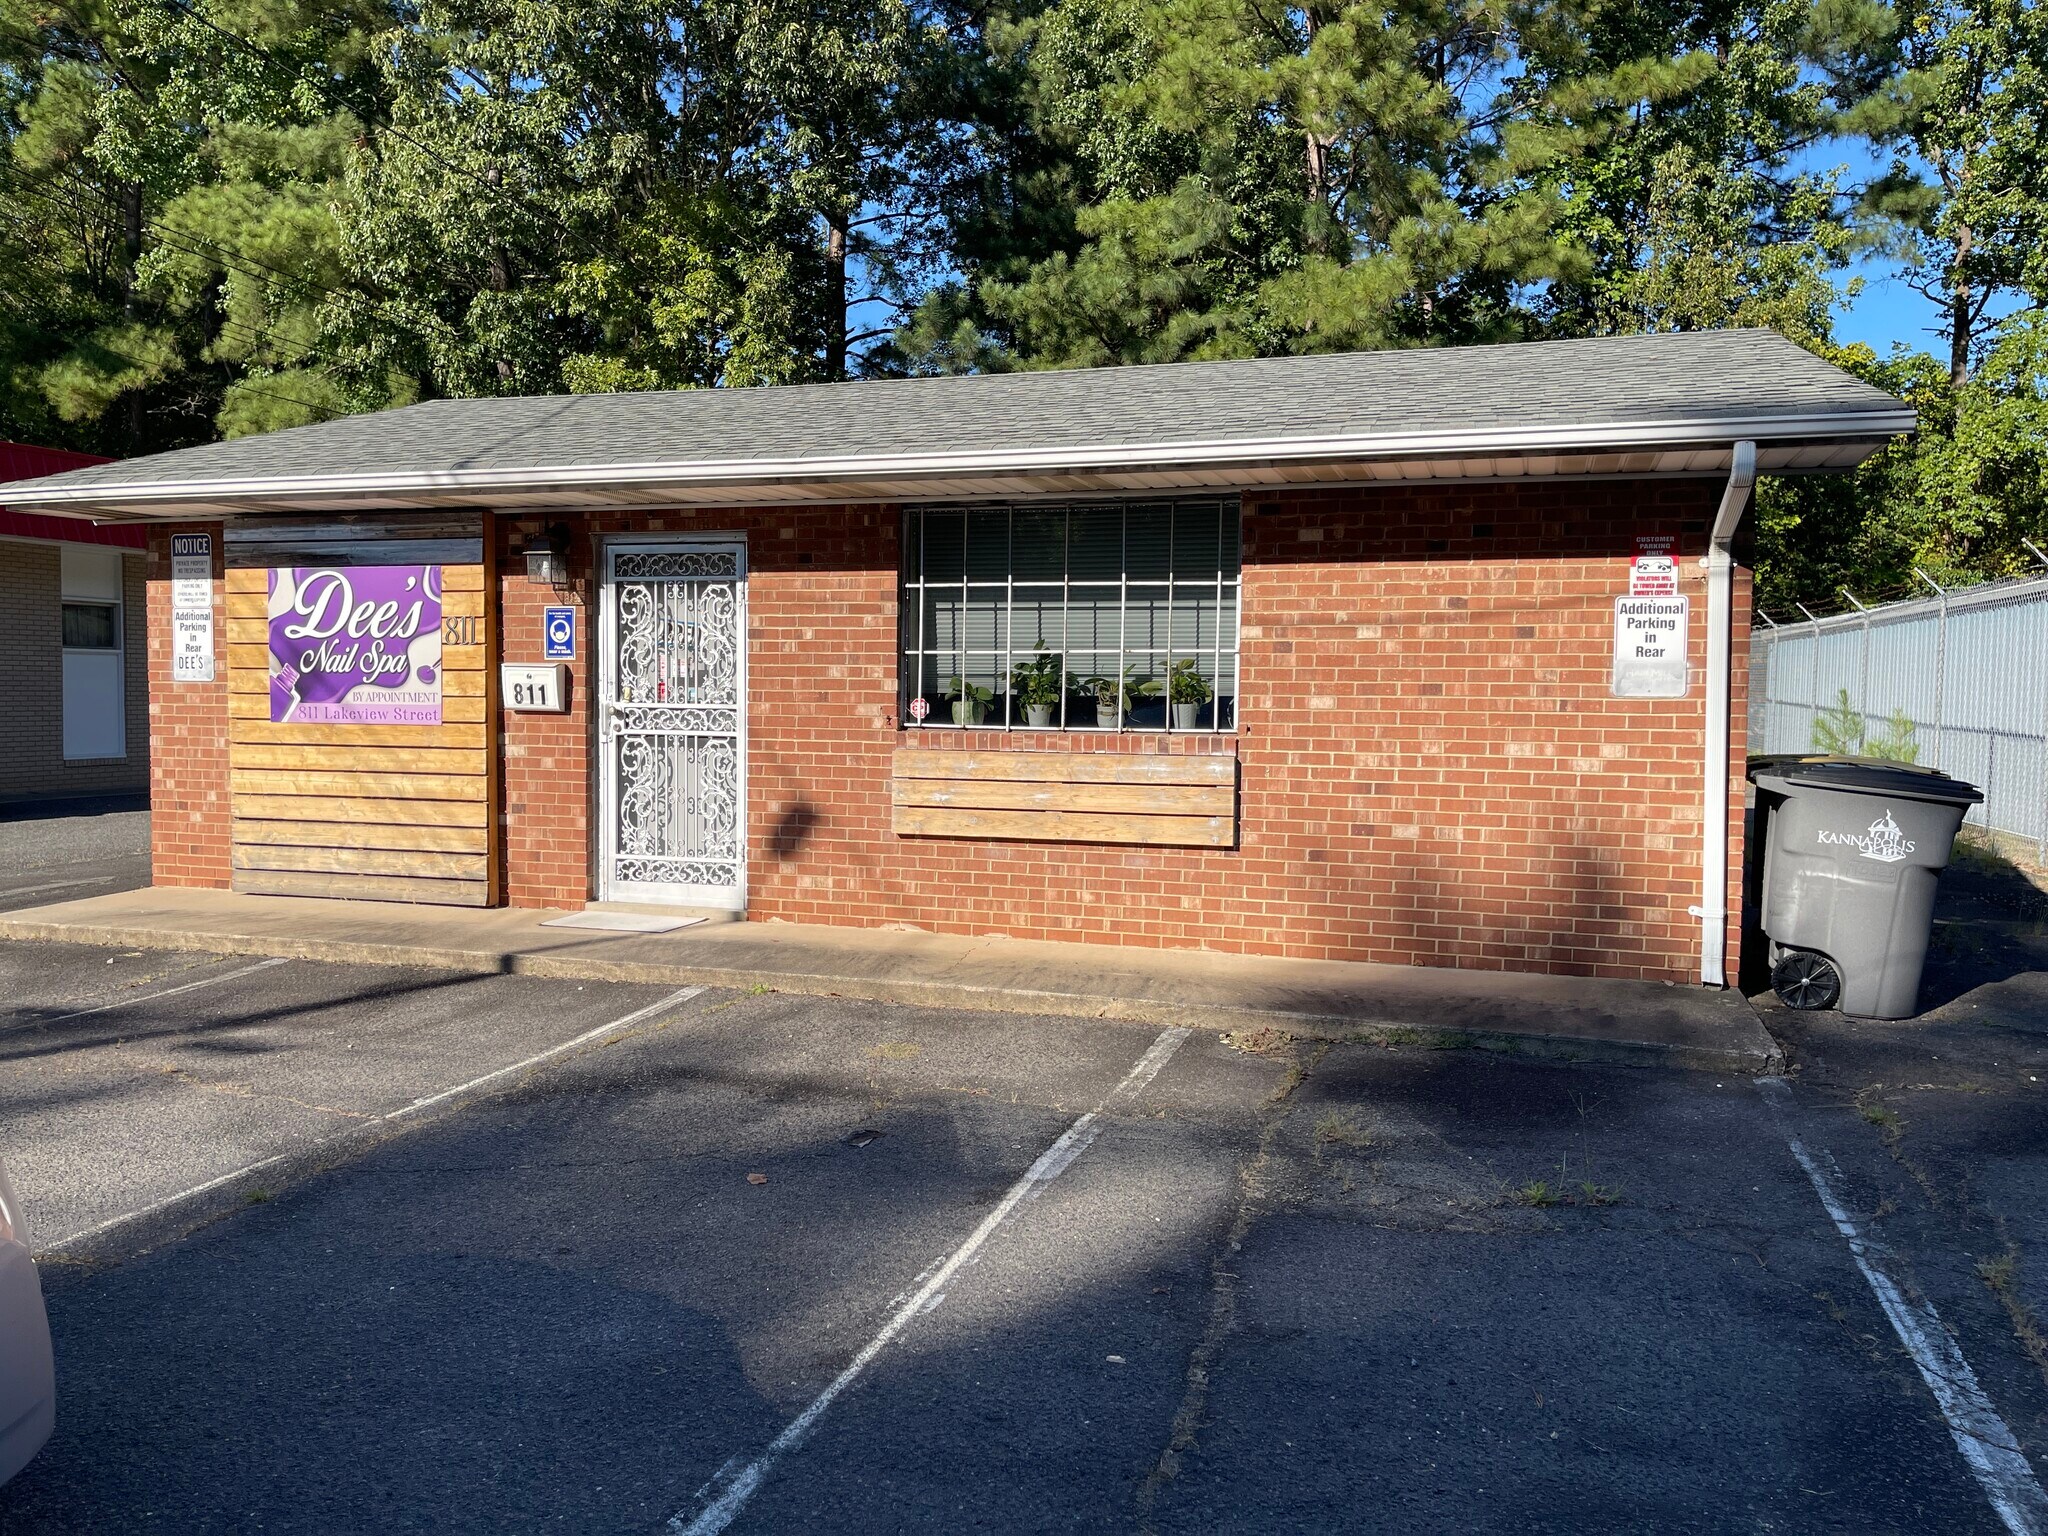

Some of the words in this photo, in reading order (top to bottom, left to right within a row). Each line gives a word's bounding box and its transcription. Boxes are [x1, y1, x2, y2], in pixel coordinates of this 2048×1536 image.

[175, 538, 208, 554] NOTICE
[284, 570, 424, 639] Dee's
[1619, 602, 1684, 615] Additional
[175, 612, 211, 621] Additional
[179, 622, 207, 633] Parking
[444, 616, 478, 646] 811
[1627, 617, 1676, 631] Parking
[189, 633, 197, 642] in
[1644, 631, 1657, 643] in
[185, 643, 202, 653] Rear
[1635, 646, 1666, 658] Rear
[178, 654, 204, 670] DEE'S
[300, 638, 360, 674] Nail
[360, 640, 408, 684] Spa
[352, 691, 366, 702] BY
[366, 692, 438, 703] APPOINTMENT
[513, 683, 546, 706] 811
[298, 706, 319, 719] 811
[324, 706, 389, 720] Lakeview
[393, 708, 441, 721] Street
[1817, 830, 1916, 853] KANNAPOLIS
